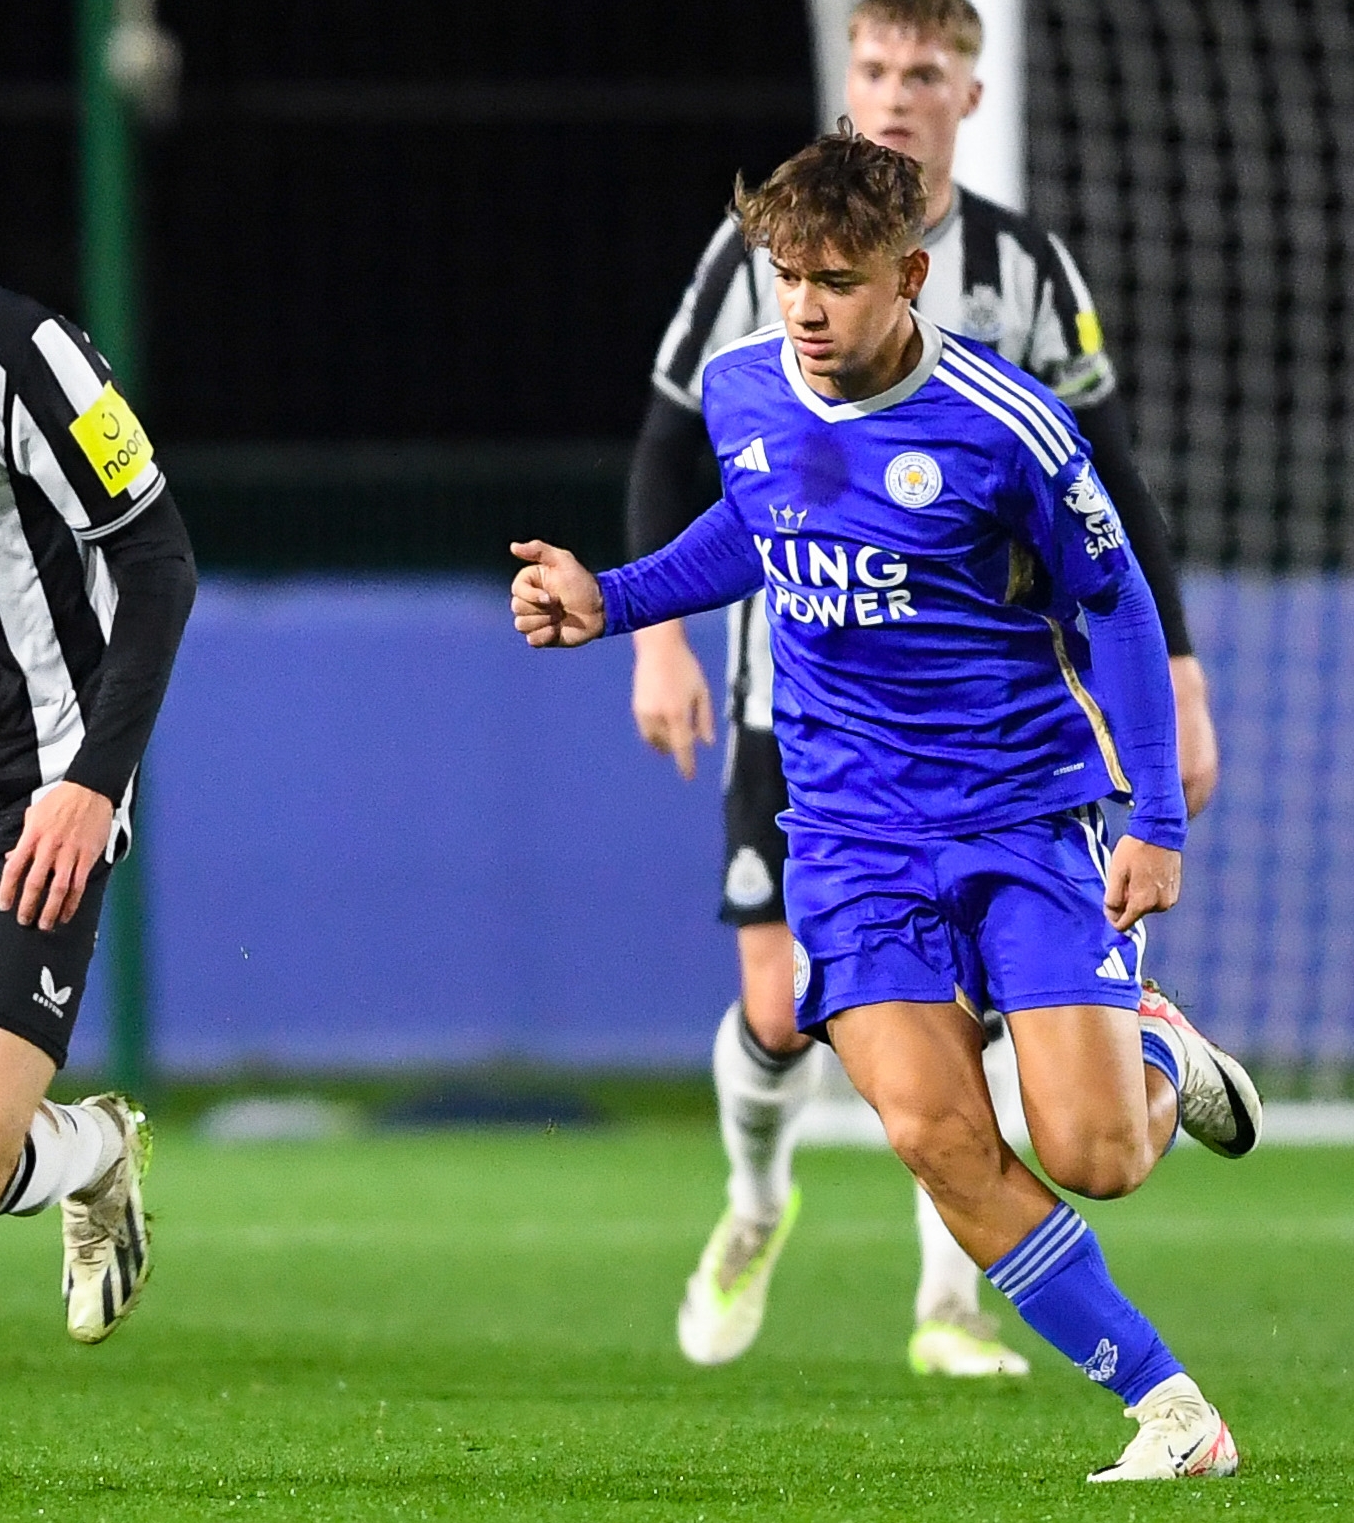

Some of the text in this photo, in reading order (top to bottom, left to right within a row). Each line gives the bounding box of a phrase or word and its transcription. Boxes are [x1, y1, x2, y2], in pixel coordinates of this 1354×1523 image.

[103, 429, 146, 480] noon
[753, 534, 908, 591] KING
[775, 584, 918, 628] POWER
